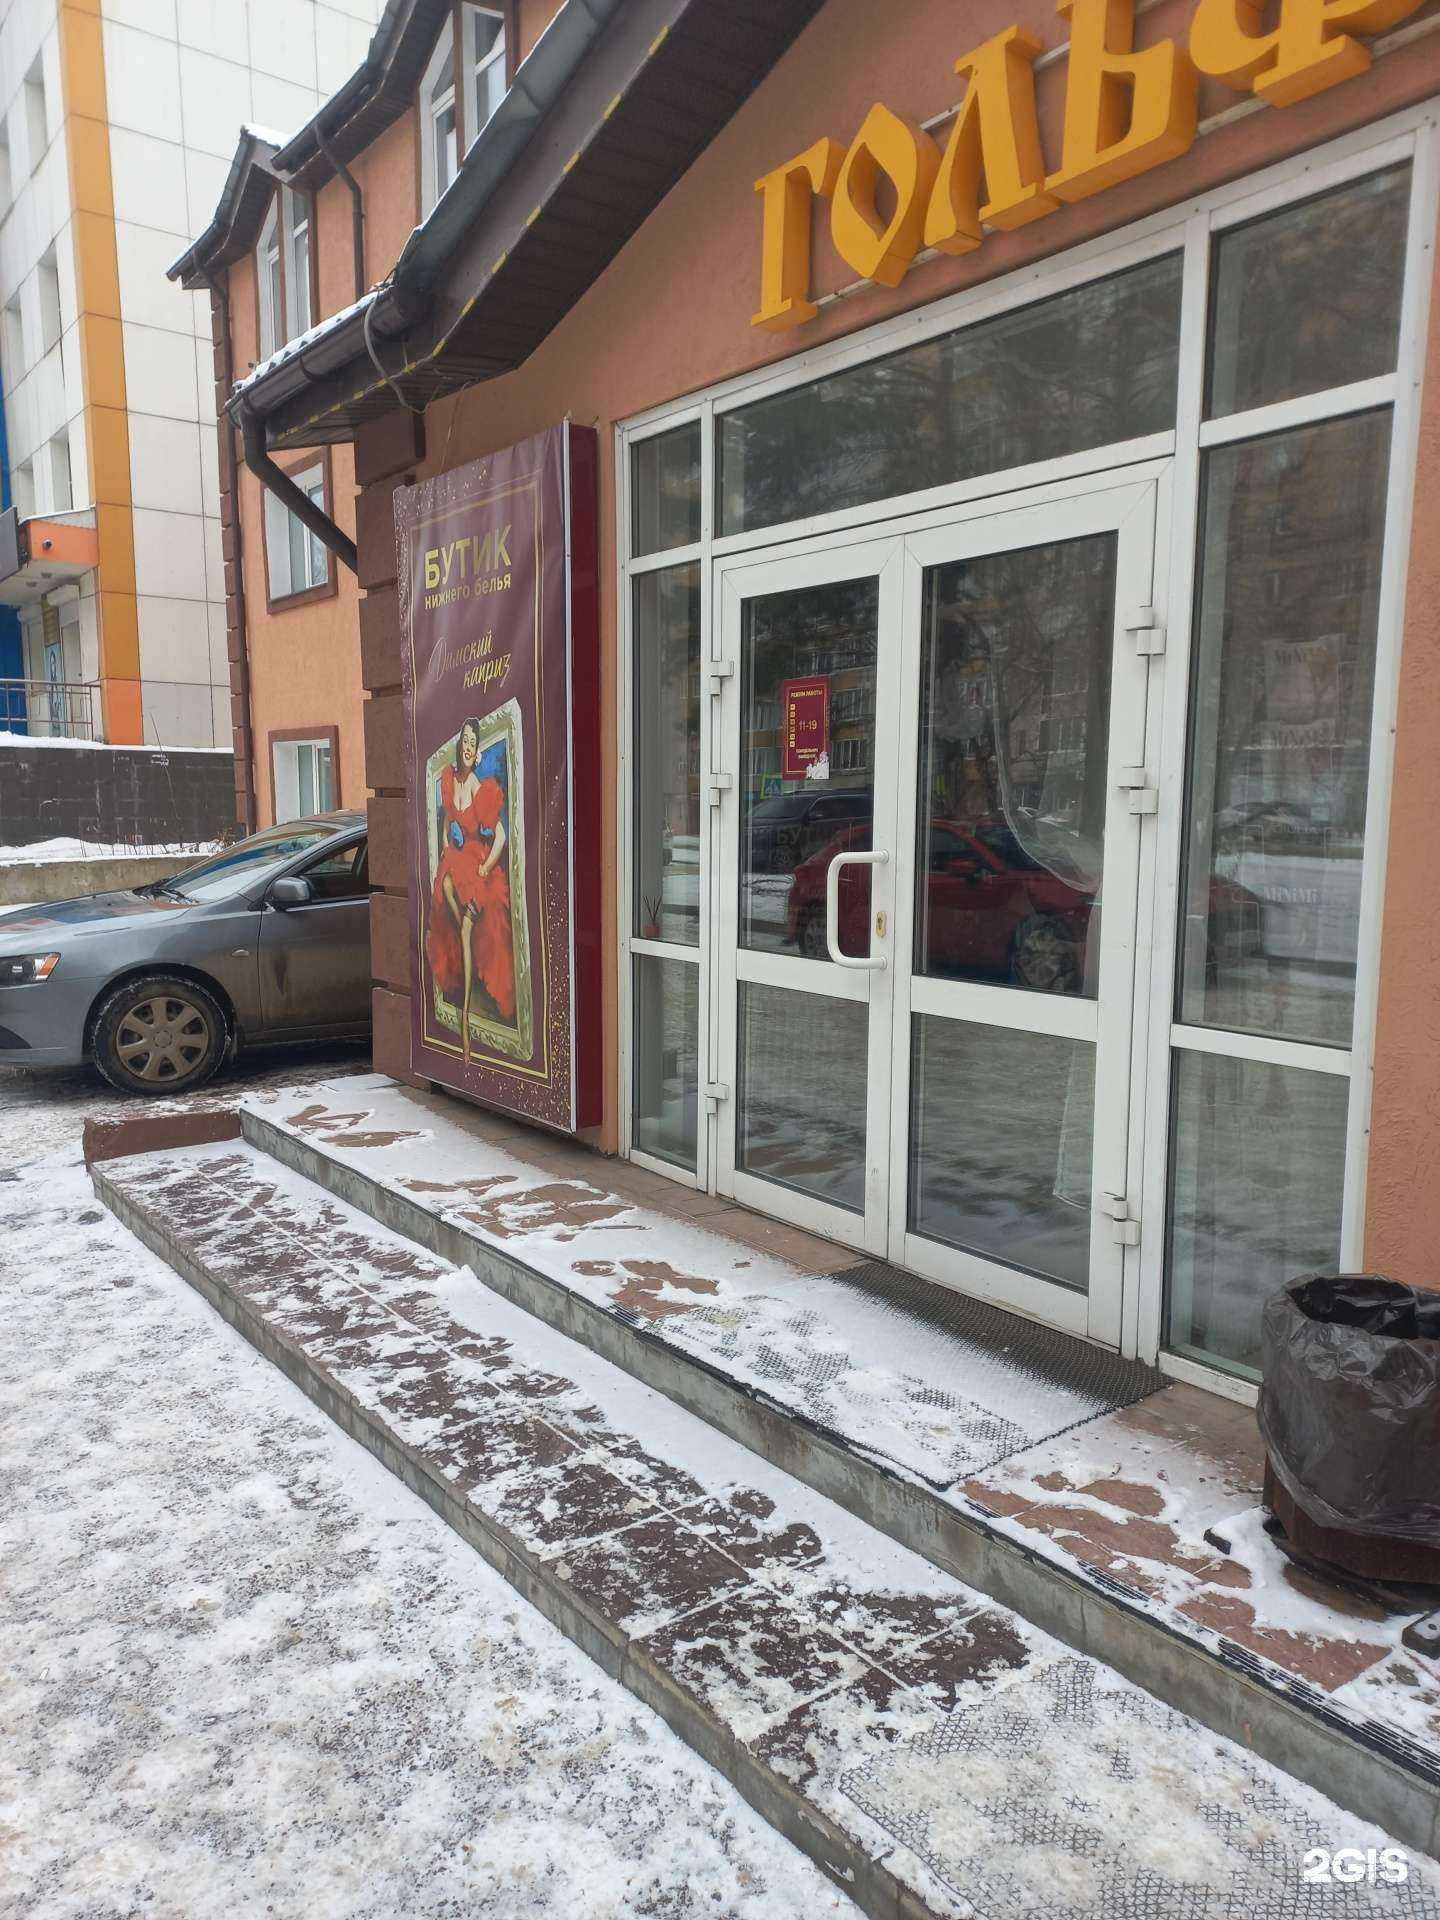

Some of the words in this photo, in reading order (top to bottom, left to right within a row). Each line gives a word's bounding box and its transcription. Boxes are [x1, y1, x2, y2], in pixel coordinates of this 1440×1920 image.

[425, 524, 512, 589] БУТИК
[424, 583, 471, 611] нижнего
[475, 572, 512, 597] белья
[463, 652, 512, 694] каприз
[799, 720, 818, 731] 11-19
